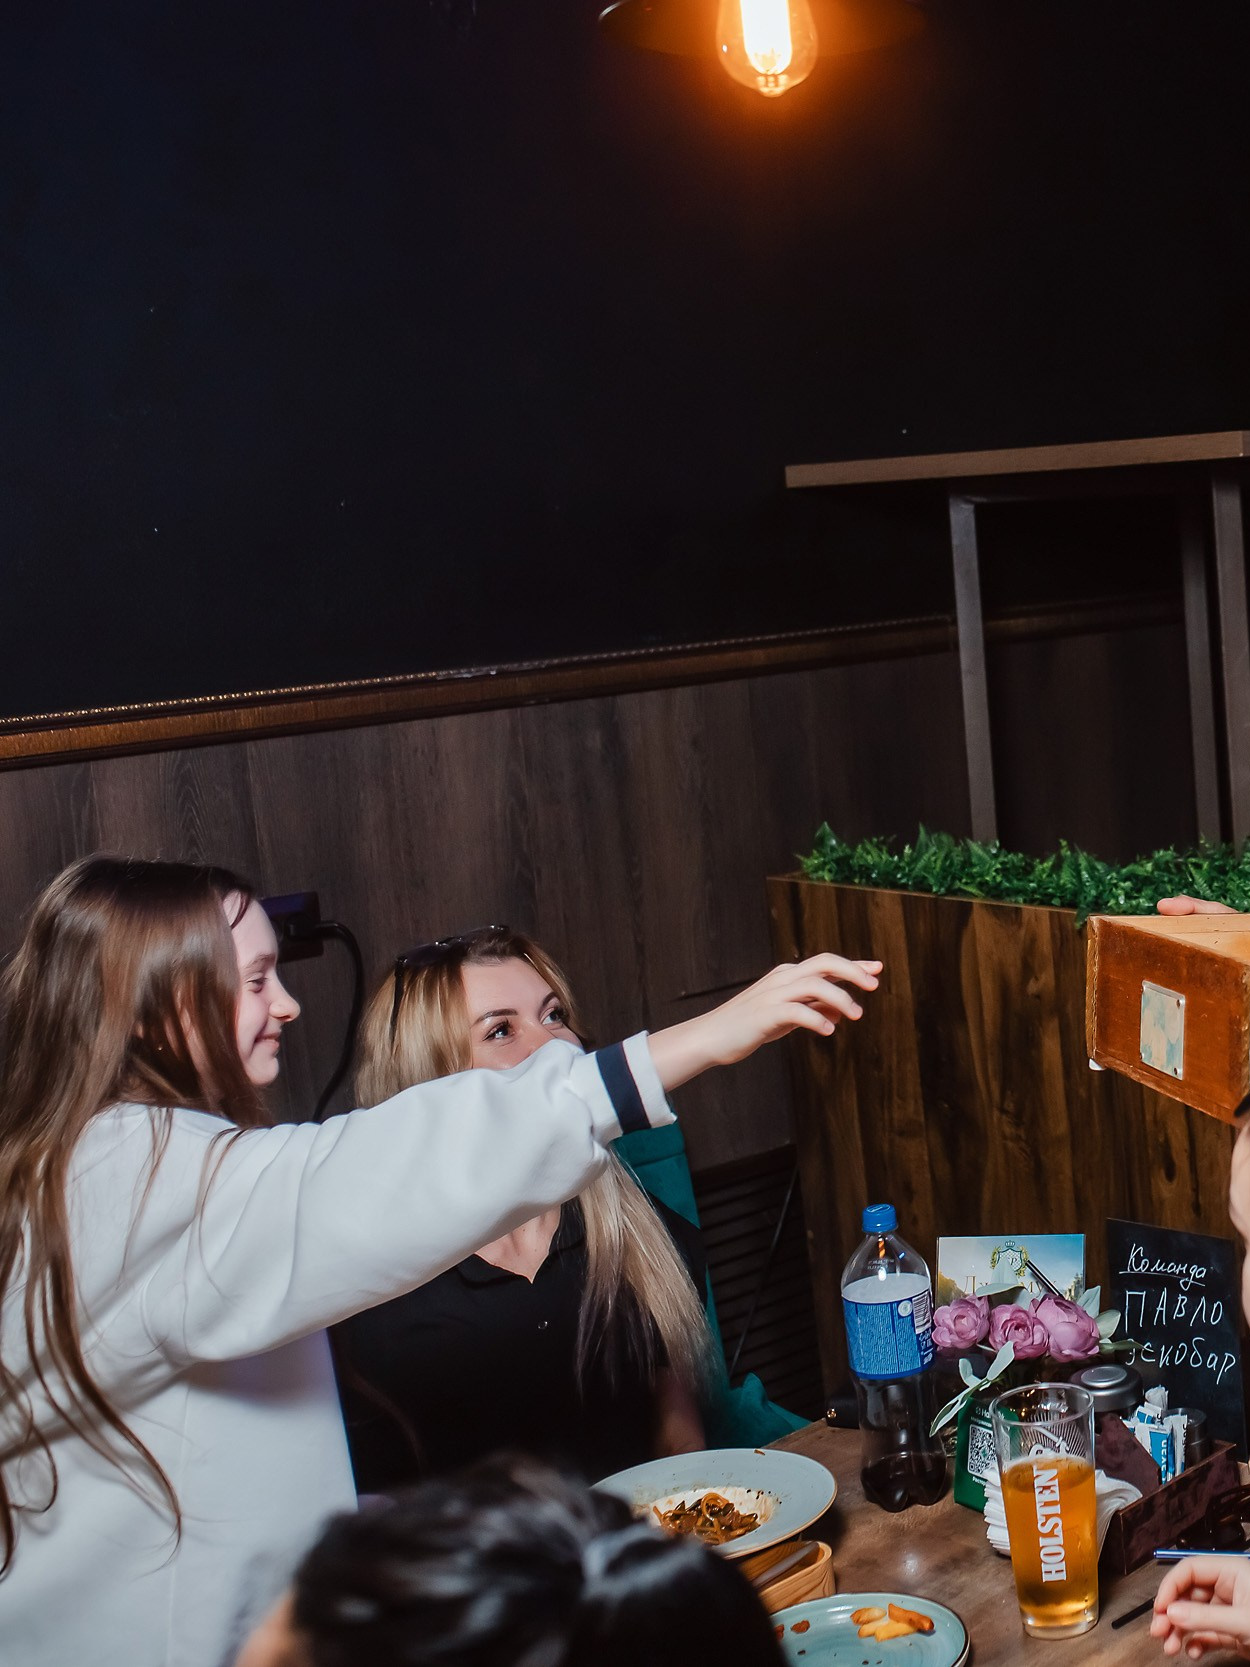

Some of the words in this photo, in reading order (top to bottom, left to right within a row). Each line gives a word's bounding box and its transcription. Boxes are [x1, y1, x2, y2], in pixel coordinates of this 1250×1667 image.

[1127, 1243, 1207, 1292] Команда
[1125, 1286, 1223, 1334] ПАВЛО
[1032, 1464, 1067, 1583] HOLSTEN
